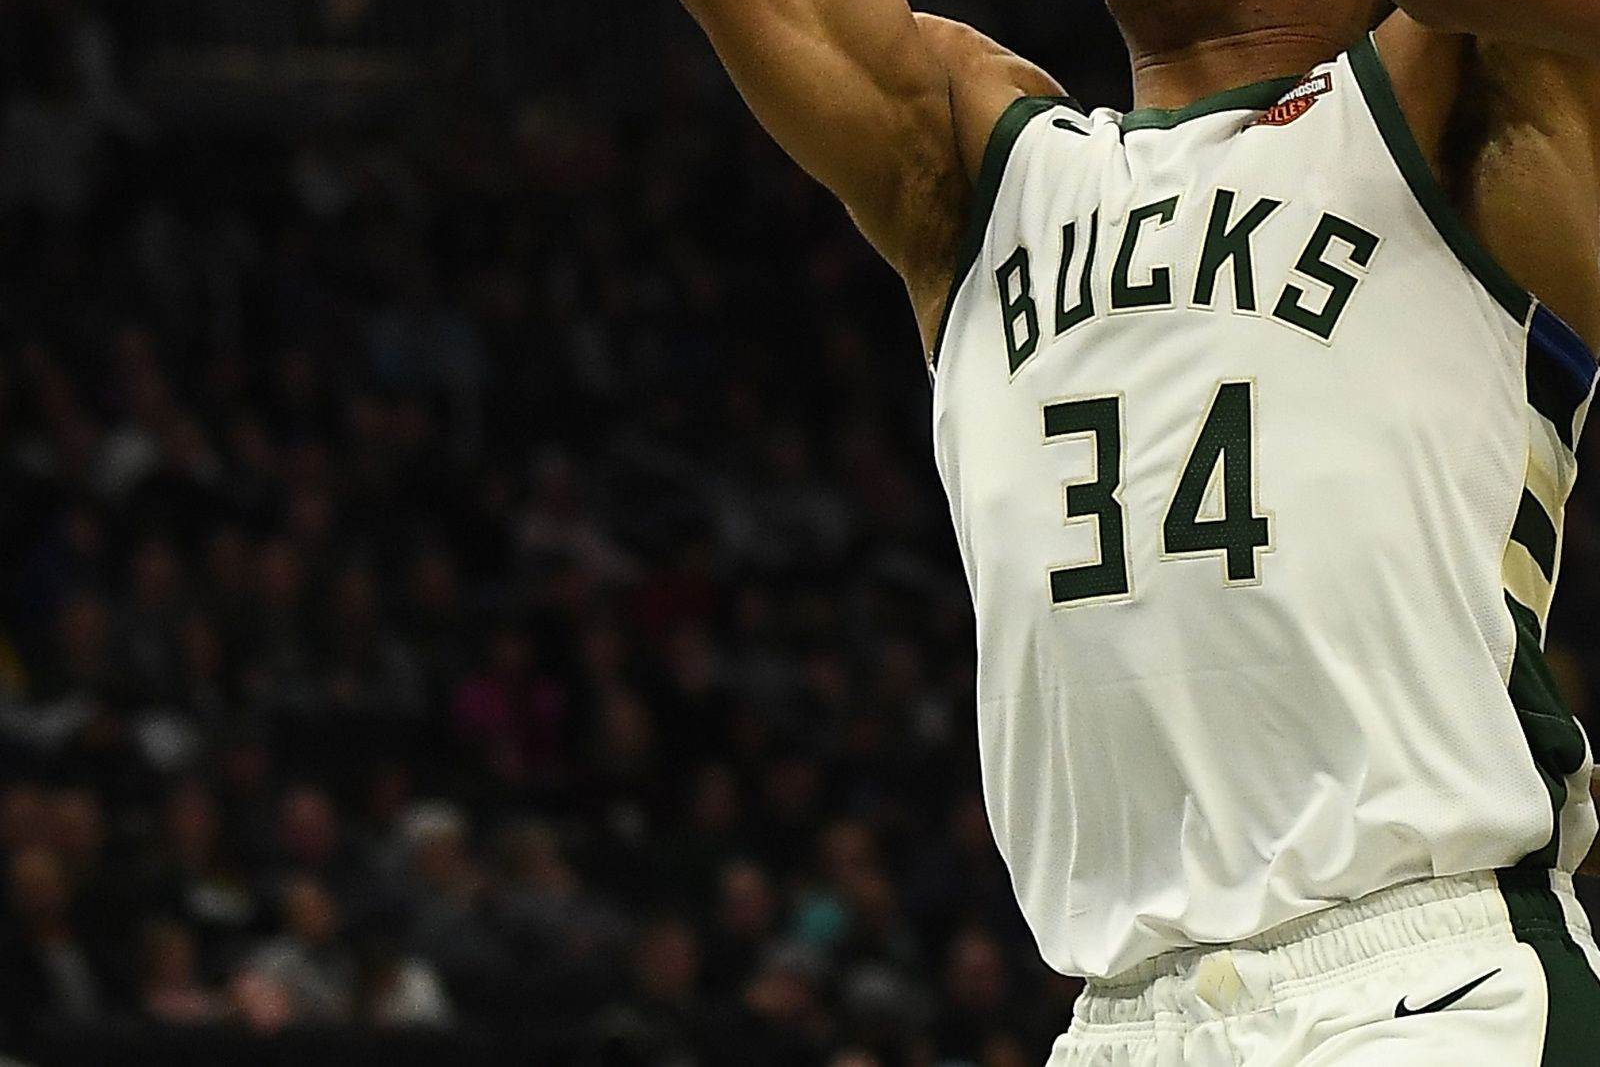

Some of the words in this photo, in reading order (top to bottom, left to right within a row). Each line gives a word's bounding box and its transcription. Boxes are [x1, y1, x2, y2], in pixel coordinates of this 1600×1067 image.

[1278, 77, 1326, 105] AVIDSON
[995, 188, 1385, 383] BUCKS
[1041, 377, 1276, 611] 34
